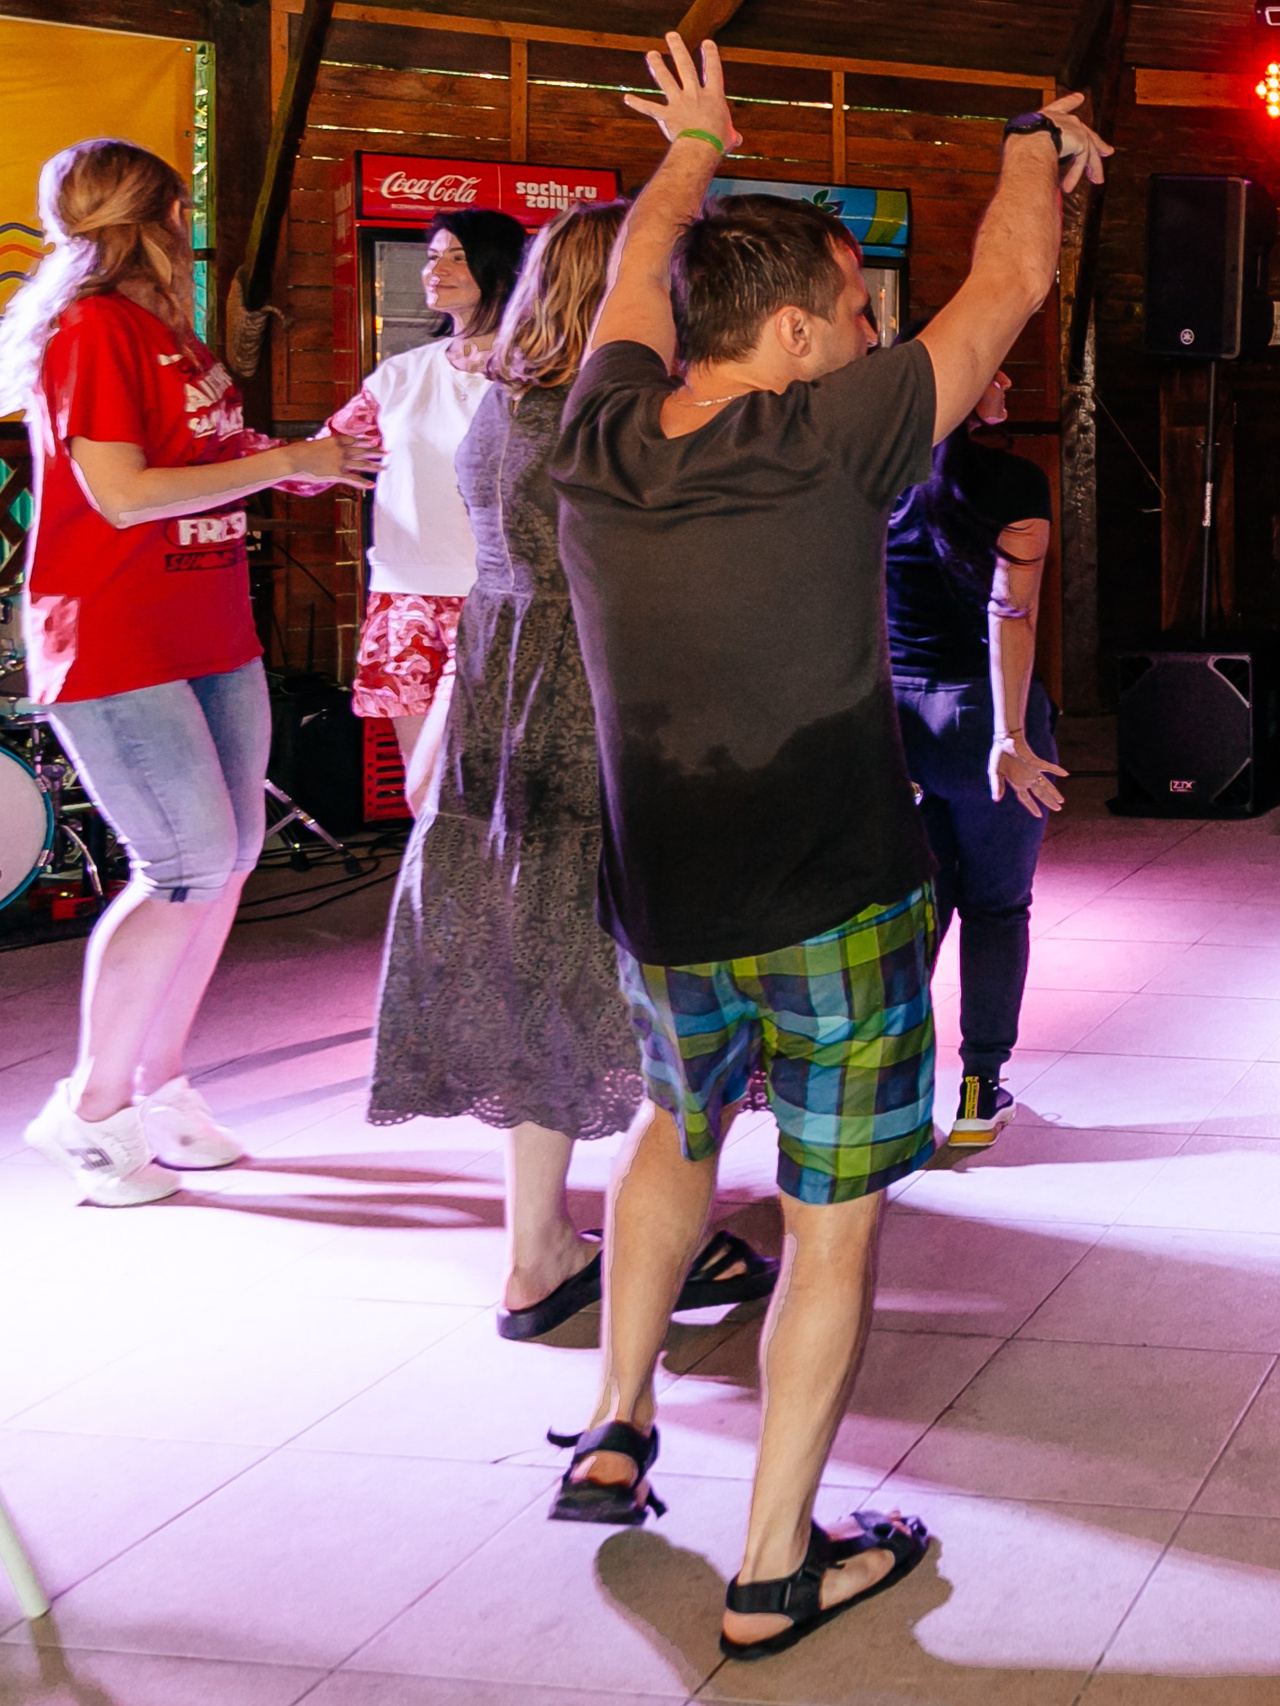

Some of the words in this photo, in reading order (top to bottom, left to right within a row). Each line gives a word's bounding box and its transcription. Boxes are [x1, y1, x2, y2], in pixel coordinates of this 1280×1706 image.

[380, 170, 481, 203] Coca-Cola
[515, 181, 597, 199] sochi.ru
[525, 195, 569, 212] 2014
